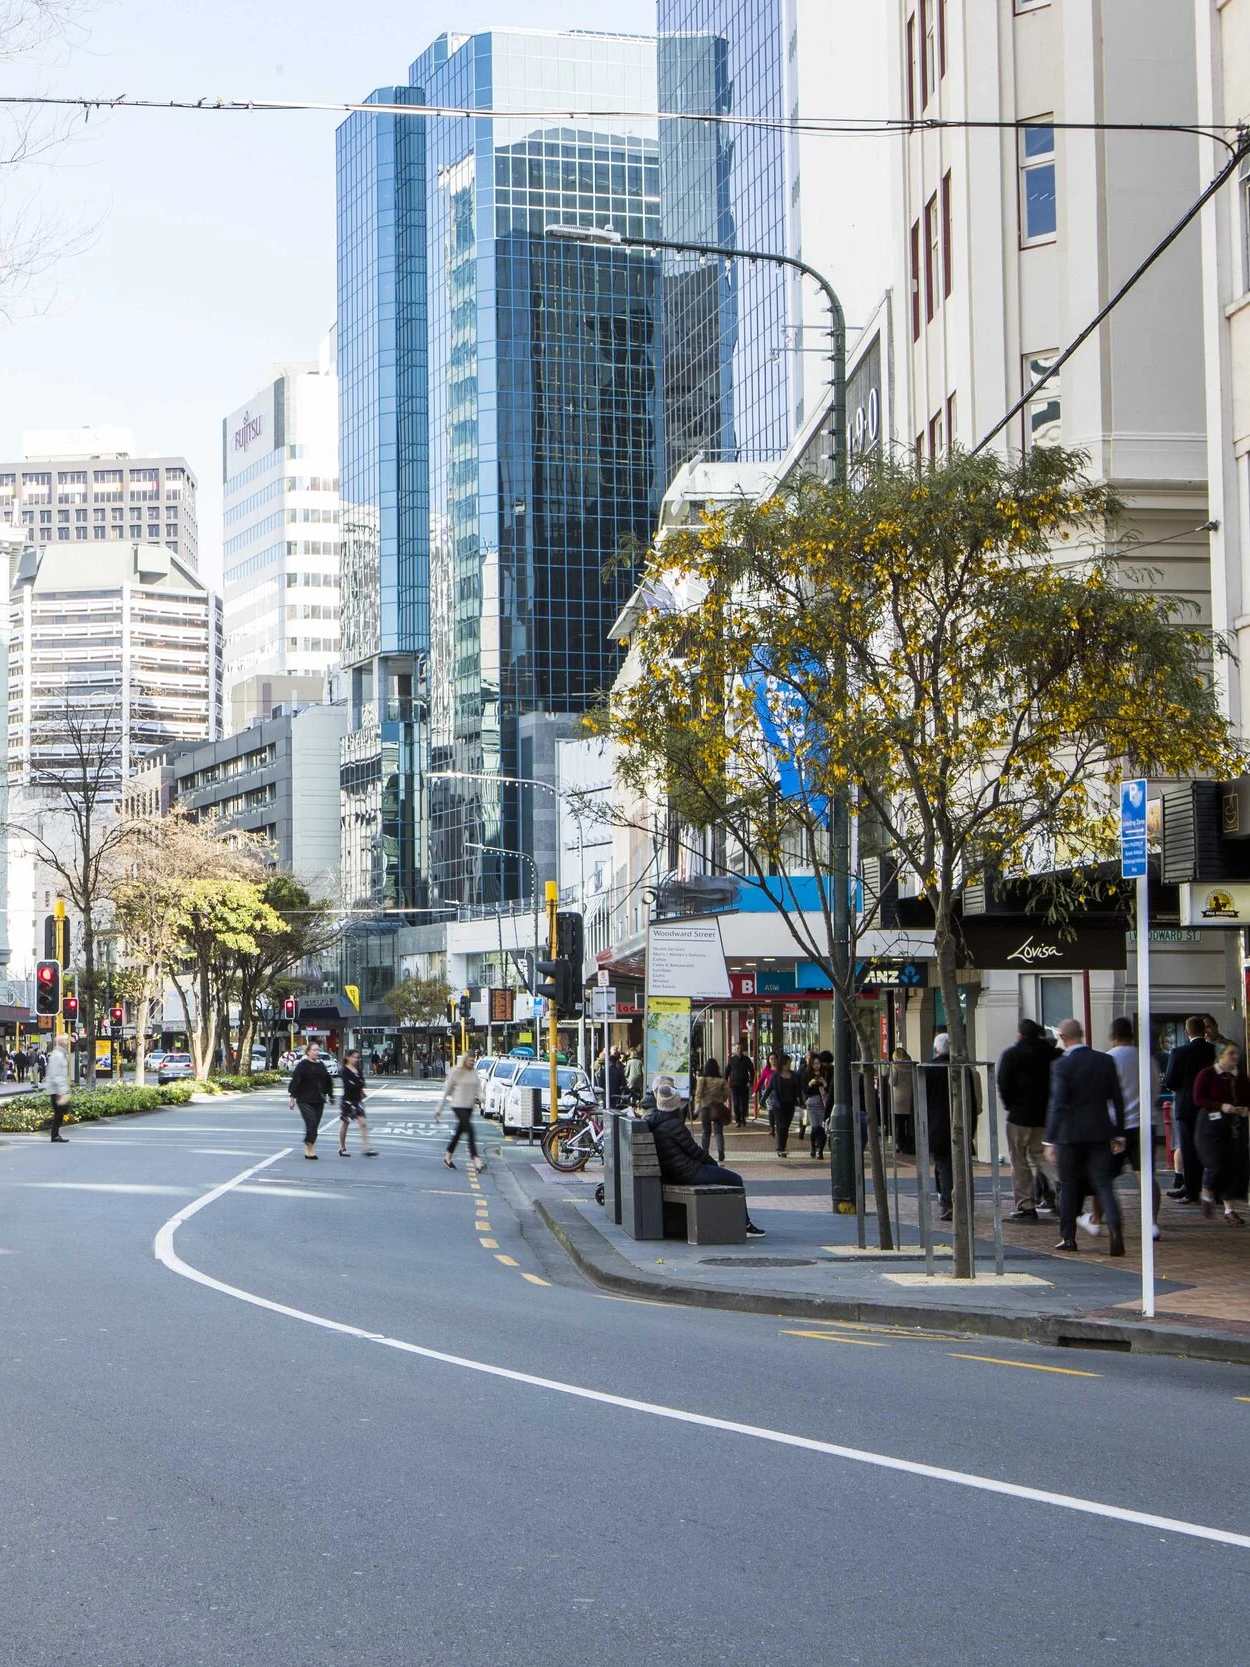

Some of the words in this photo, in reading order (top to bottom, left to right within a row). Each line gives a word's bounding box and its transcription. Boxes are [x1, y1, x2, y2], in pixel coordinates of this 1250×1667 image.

[235, 415, 260, 452] FUJITSU
[1133, 929, 1182, 941] WODWARD
[1186, 929, 1198, 941] ST
[1007, 935, 1063, 963] Lovisa
[863, 970, 899, 983] ANZ
